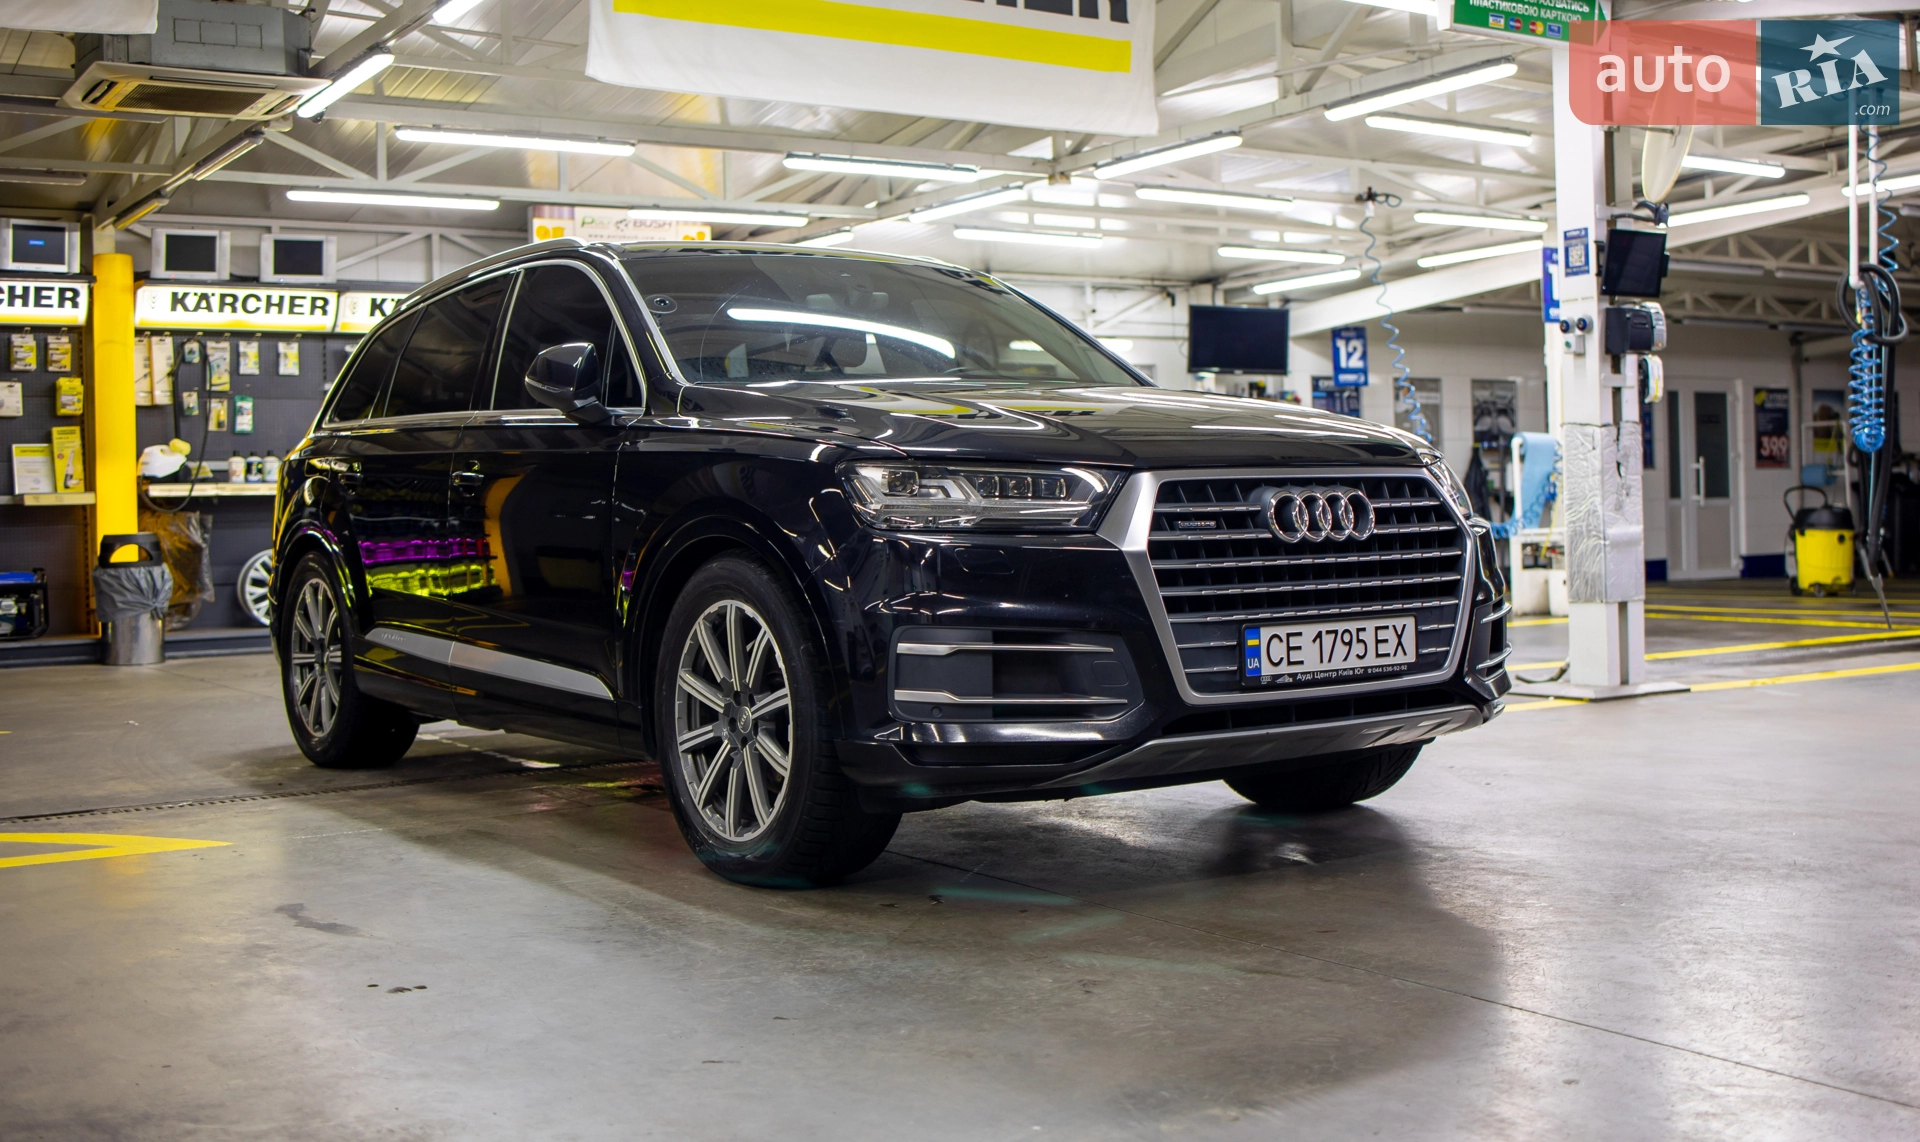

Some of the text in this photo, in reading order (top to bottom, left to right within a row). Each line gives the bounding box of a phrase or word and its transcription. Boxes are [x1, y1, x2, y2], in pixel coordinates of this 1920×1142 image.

[1540, 8, 1583, 24] КАРТКОЮ
[0, 285, 81, 309] HER
[169, 291, 330, 316] KÄRCHER
[1335, 338, 1365, 369] 12
[1760, 436, 1788, 457] 399
[1266, 623, 1407, 667] CE 1795 EX
[1247, 658, 1260, 668] UA
[1296, 672, 1313, 682] Ауді
[1314, 670, 1337, 679] Центр
